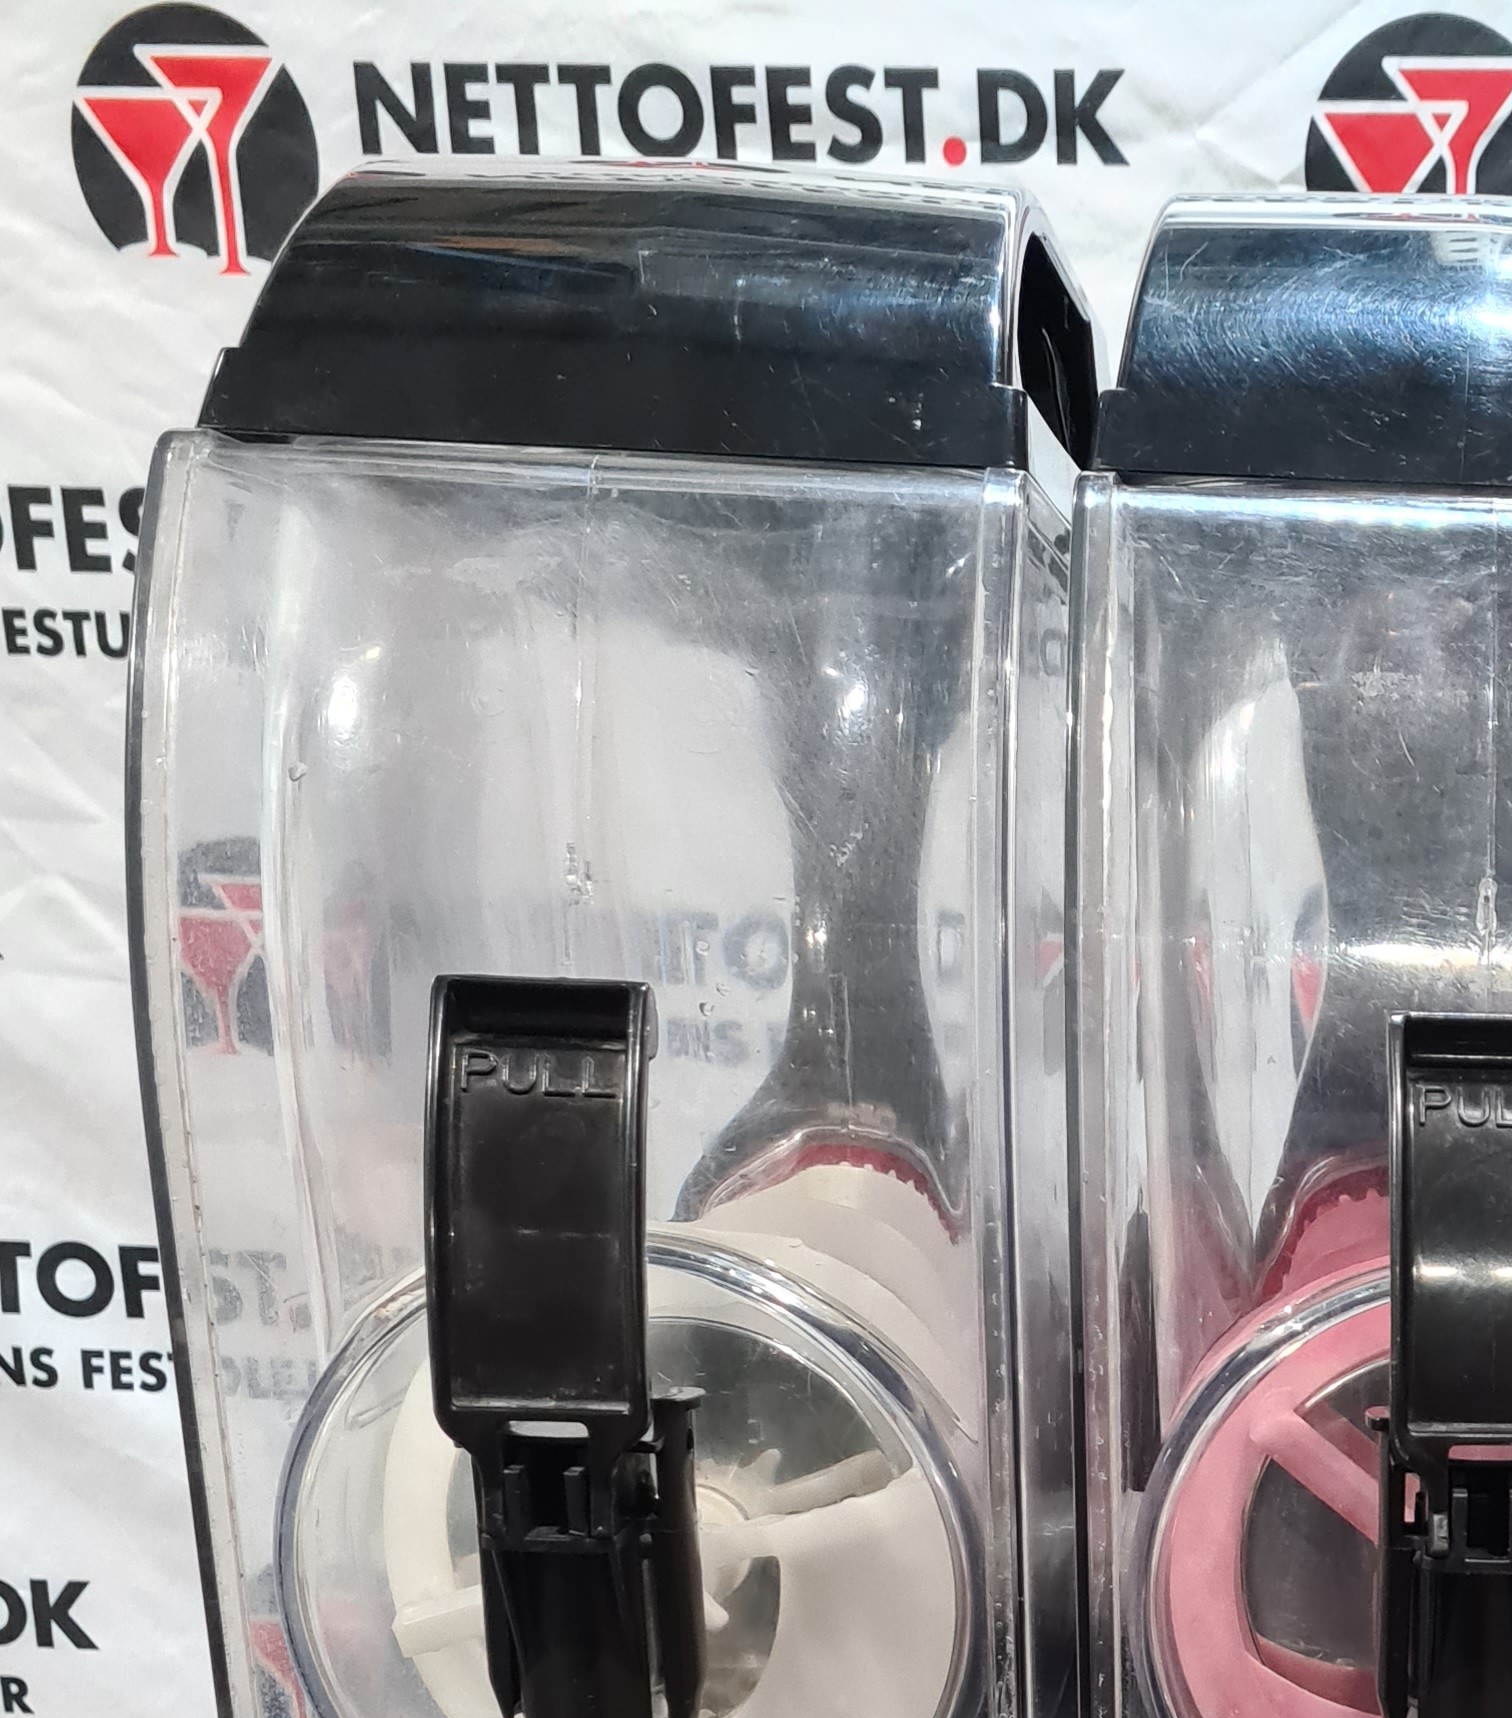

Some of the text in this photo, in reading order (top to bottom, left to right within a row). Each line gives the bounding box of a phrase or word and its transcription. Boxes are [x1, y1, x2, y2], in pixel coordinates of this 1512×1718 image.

[352, 60, 1131, 168] NETTOFEST.DK
[460, 1050, 617, 1098] PULL
[81, 1349, 173, 1392] FES
